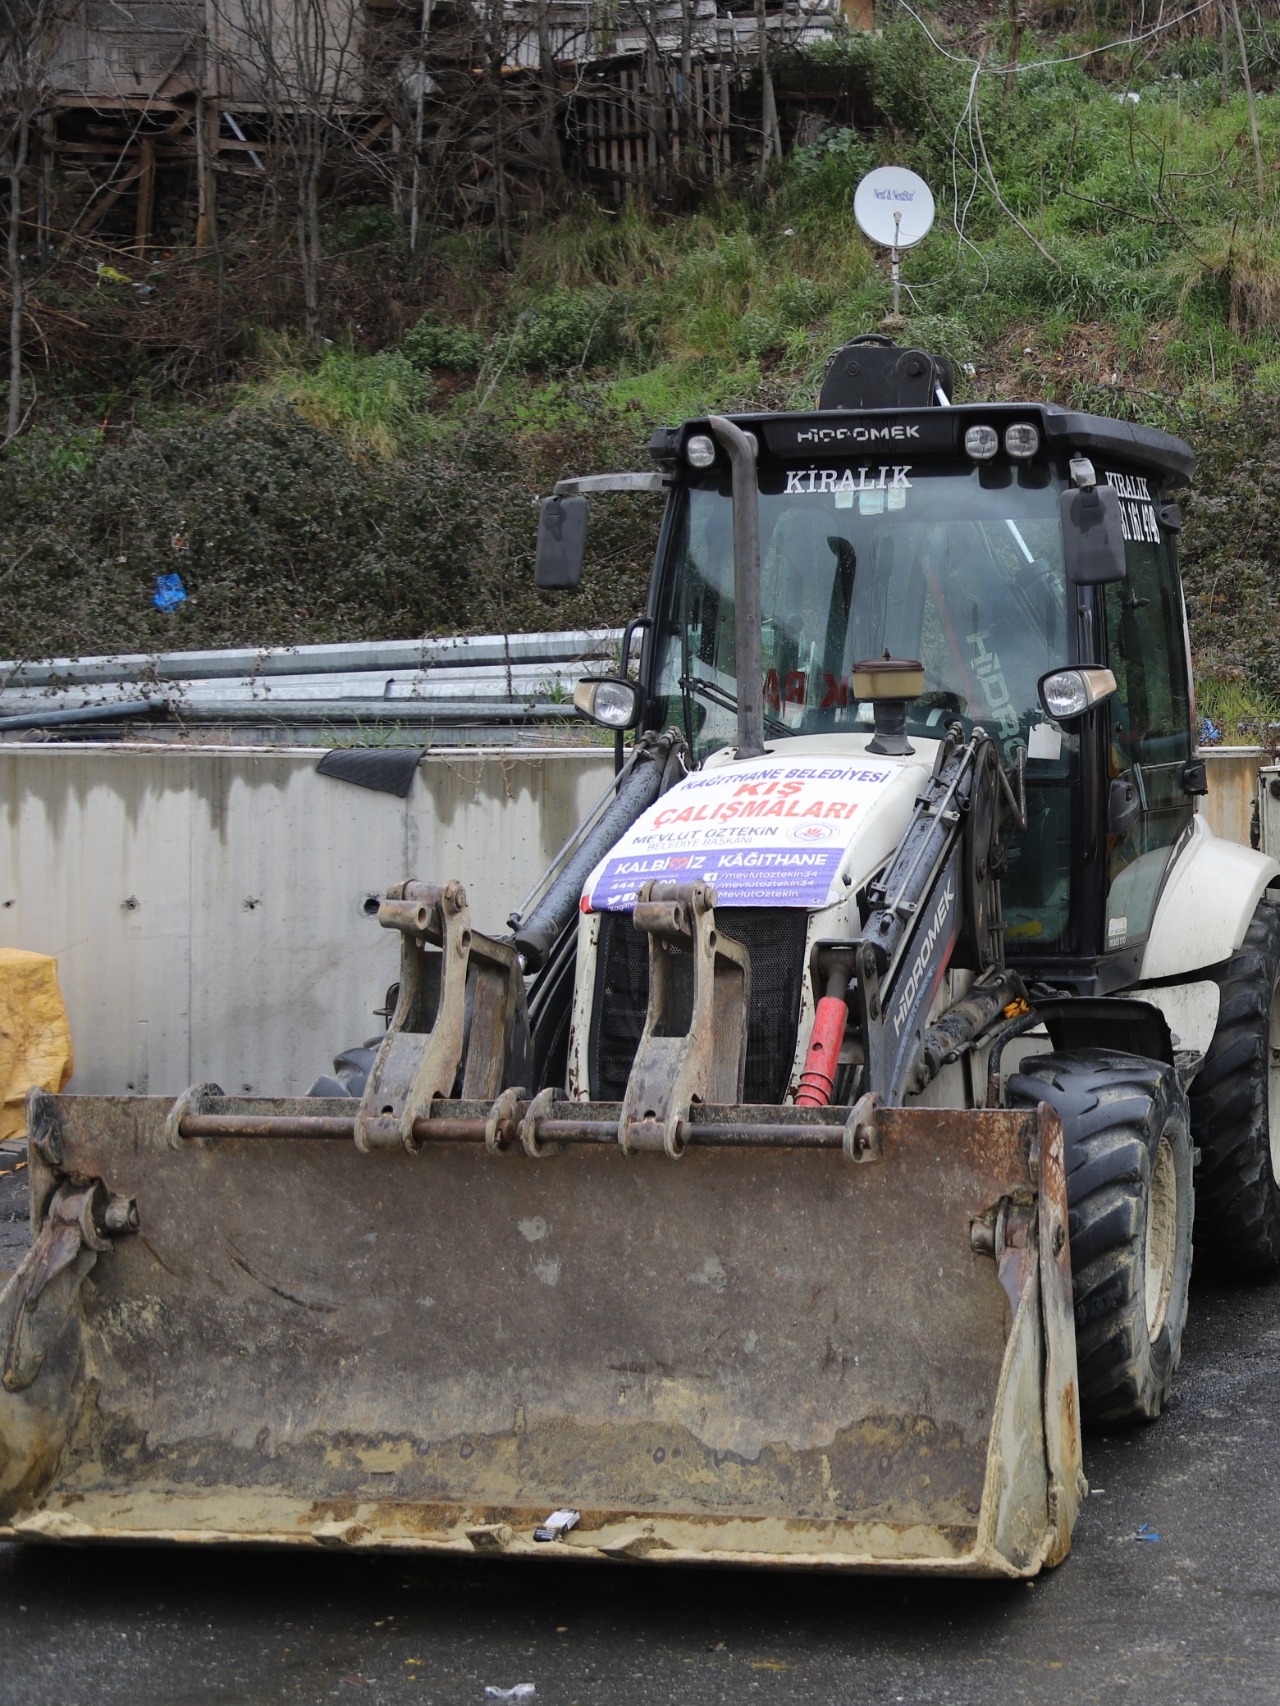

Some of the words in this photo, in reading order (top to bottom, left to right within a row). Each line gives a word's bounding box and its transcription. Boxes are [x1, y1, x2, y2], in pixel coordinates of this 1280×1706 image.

[784, 464, 913, 494] KİRALIK
[785, 766, 891, 783] BELEDİYESİ
[732, 781, 805, 798] KIŞ
[650, 799, 859, 831] ÇALIŞMALARI
[717, 851, 829, 868] KÂĞITHANE
[610, 881, 635, 890] 444
